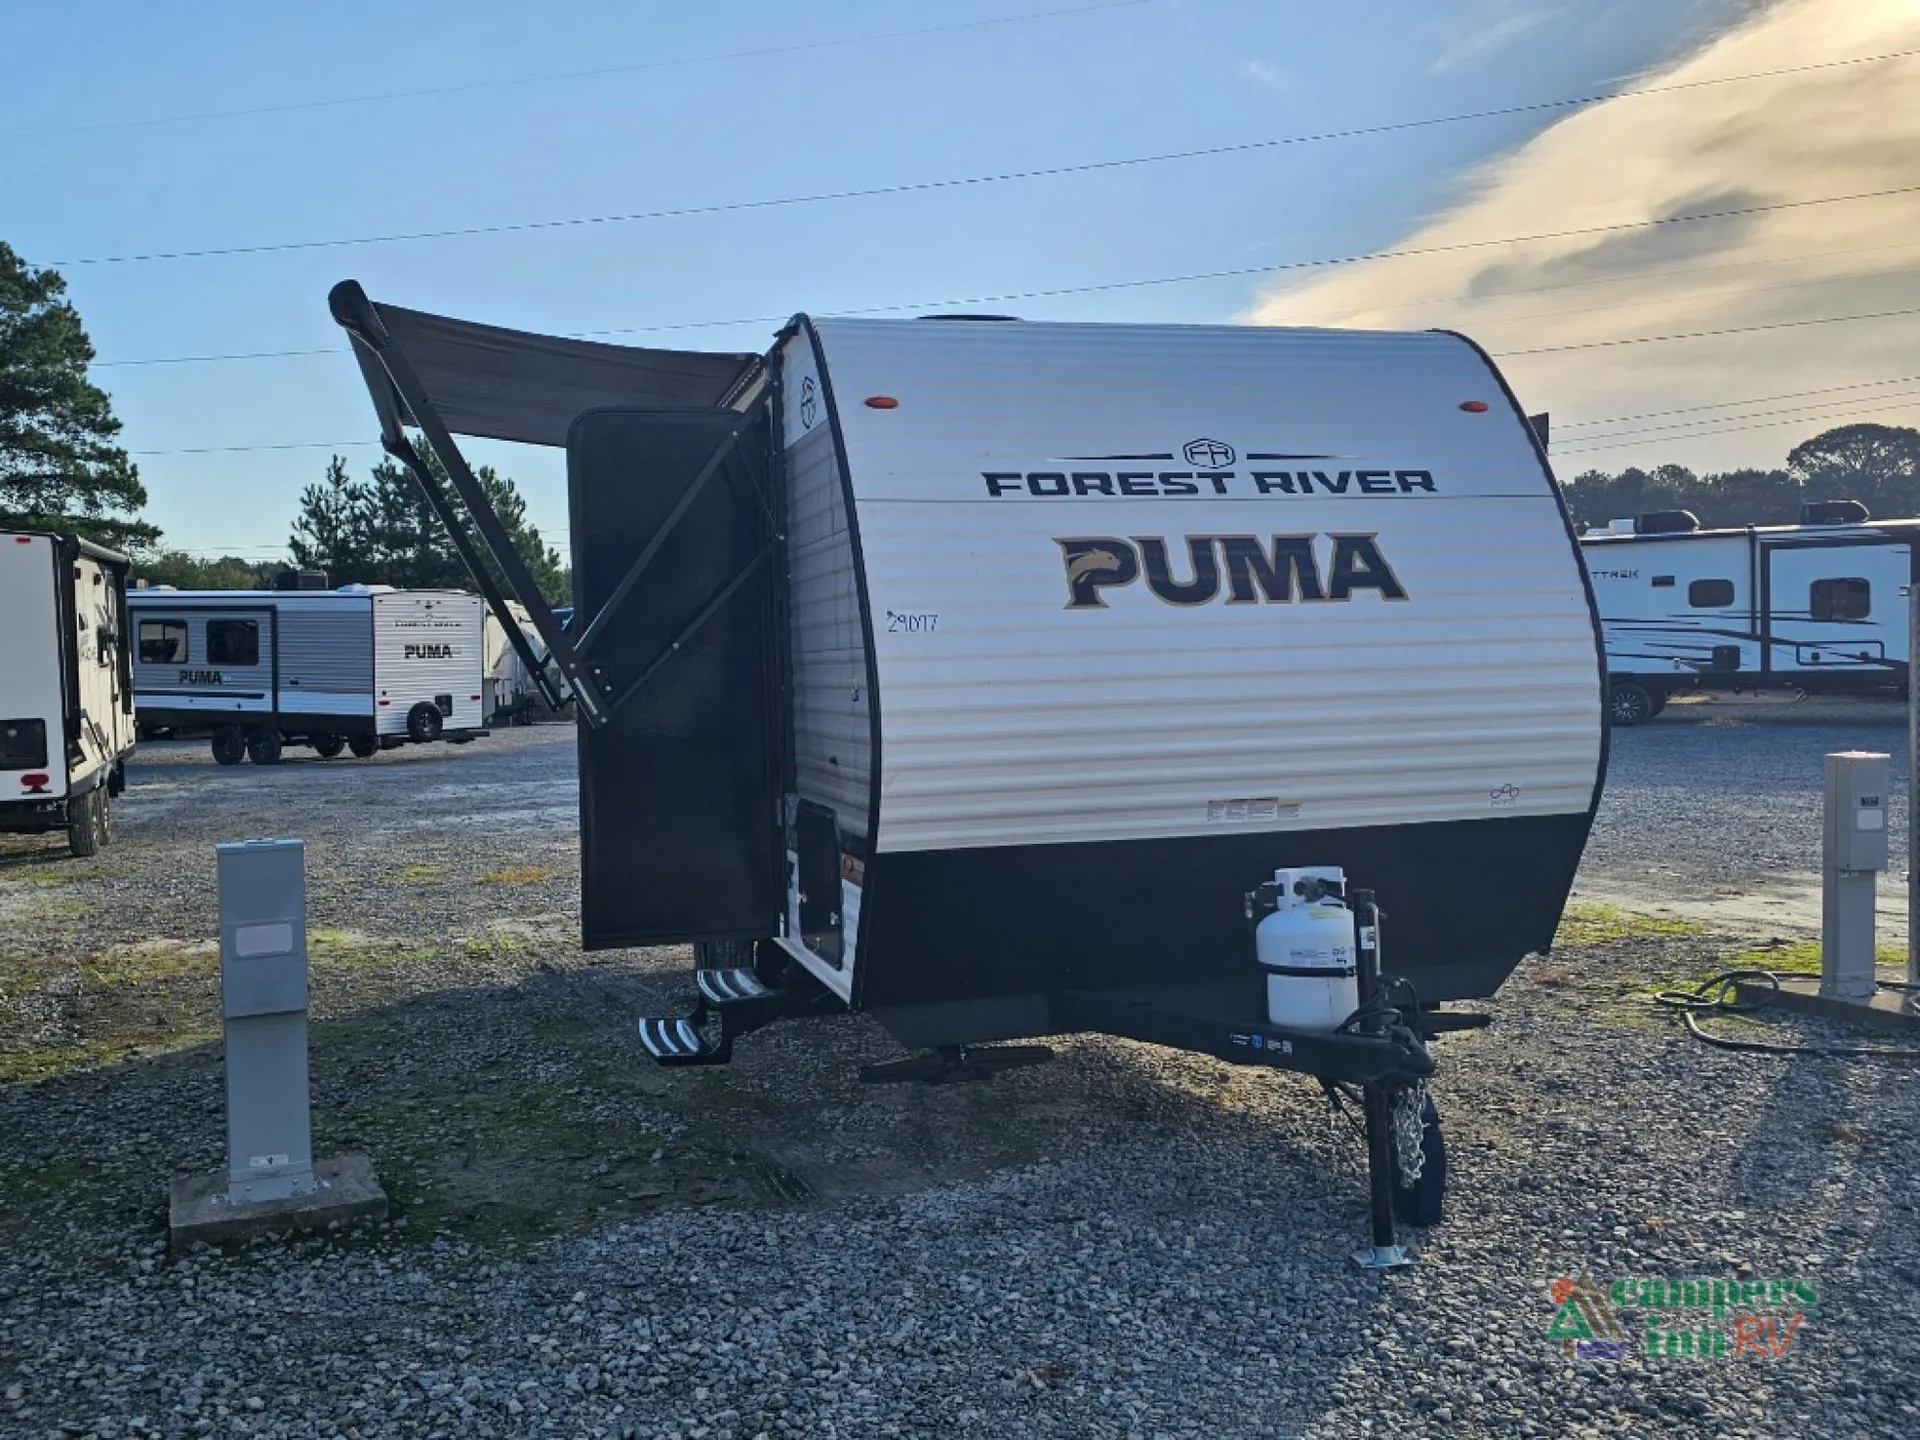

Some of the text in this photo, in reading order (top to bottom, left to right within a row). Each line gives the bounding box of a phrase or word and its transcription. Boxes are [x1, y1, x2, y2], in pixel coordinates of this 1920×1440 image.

[981, 470, 1437, 496] FOREST RIVER
[1053, 532, 1410, 610] PUMA
[404, 644, 453, 659] PUMA
[180, 670, 222, 685] PUMA
